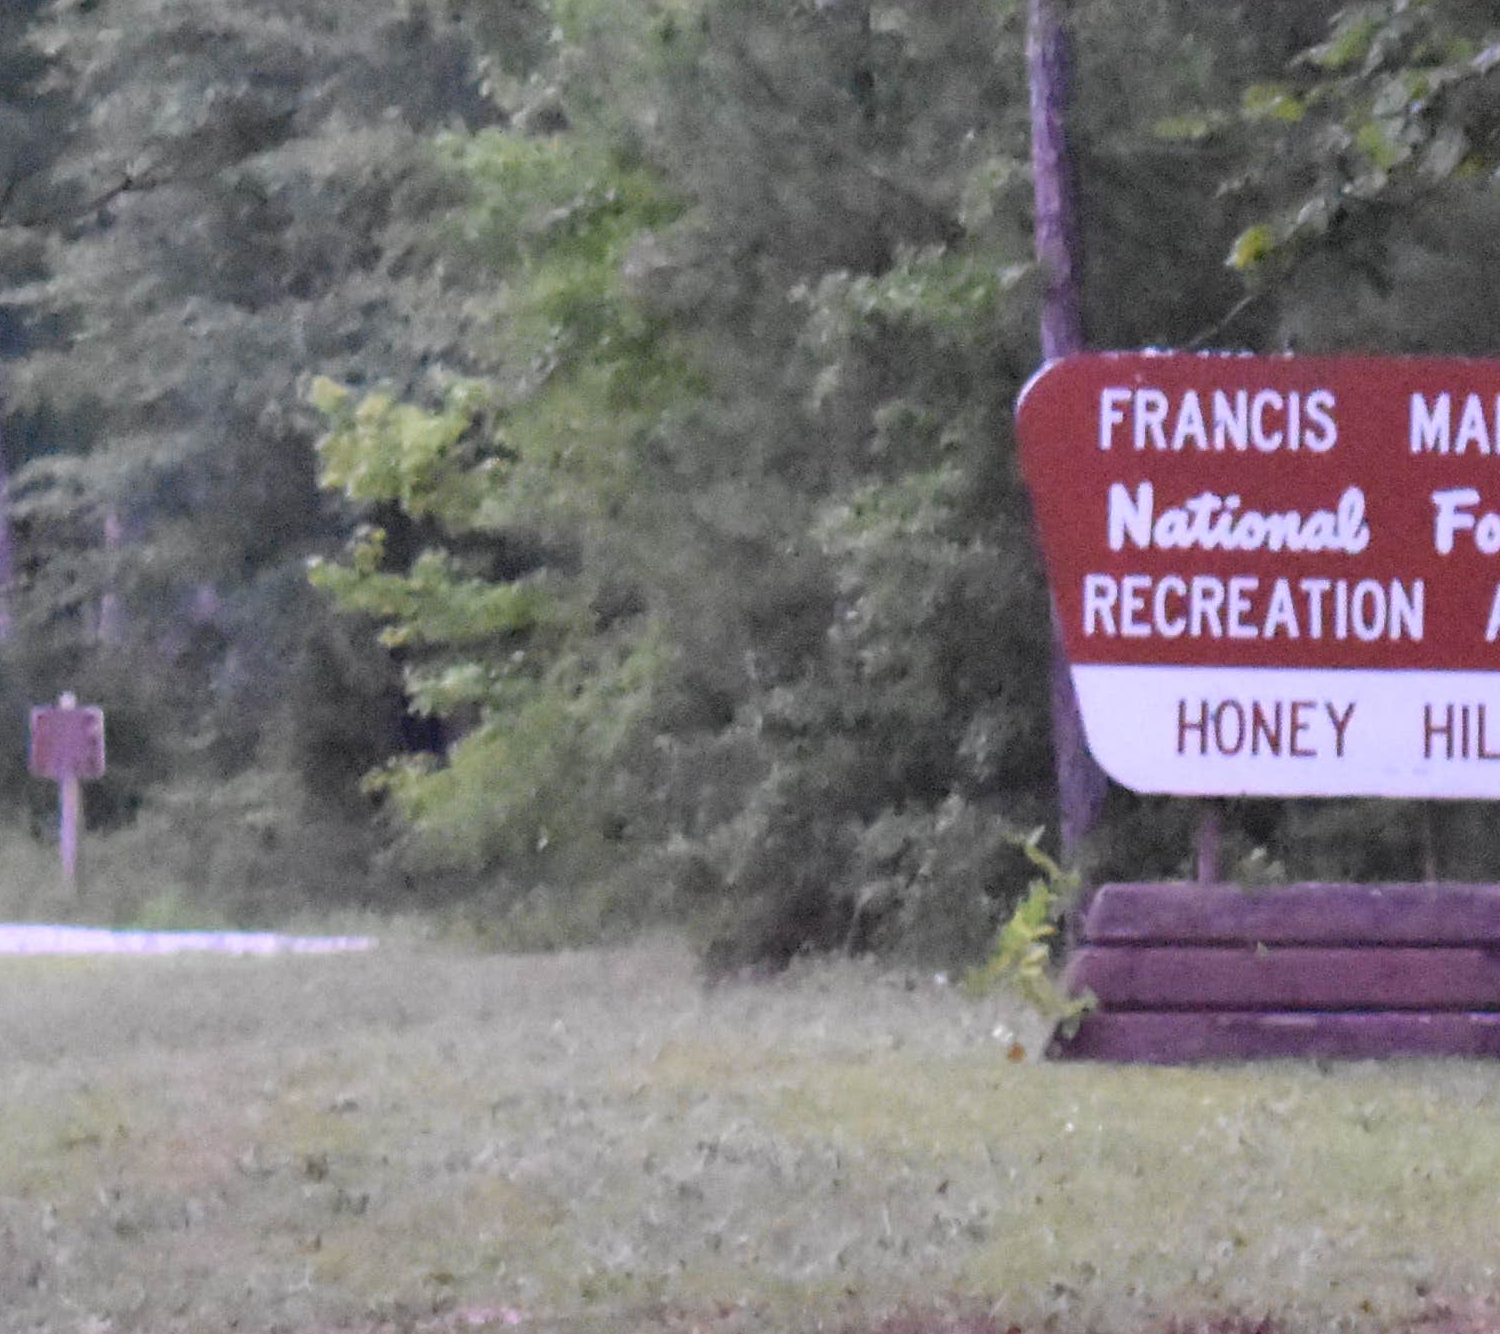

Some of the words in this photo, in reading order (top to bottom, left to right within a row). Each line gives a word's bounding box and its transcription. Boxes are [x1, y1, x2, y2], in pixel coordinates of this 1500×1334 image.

[1100, 388, 1337, 452] FRANCIS
[1109, 482, 1369, 553] National
[1084, 574, 1423, 641] RECREATION
[1177, 699, 1355, 757] HONEY
